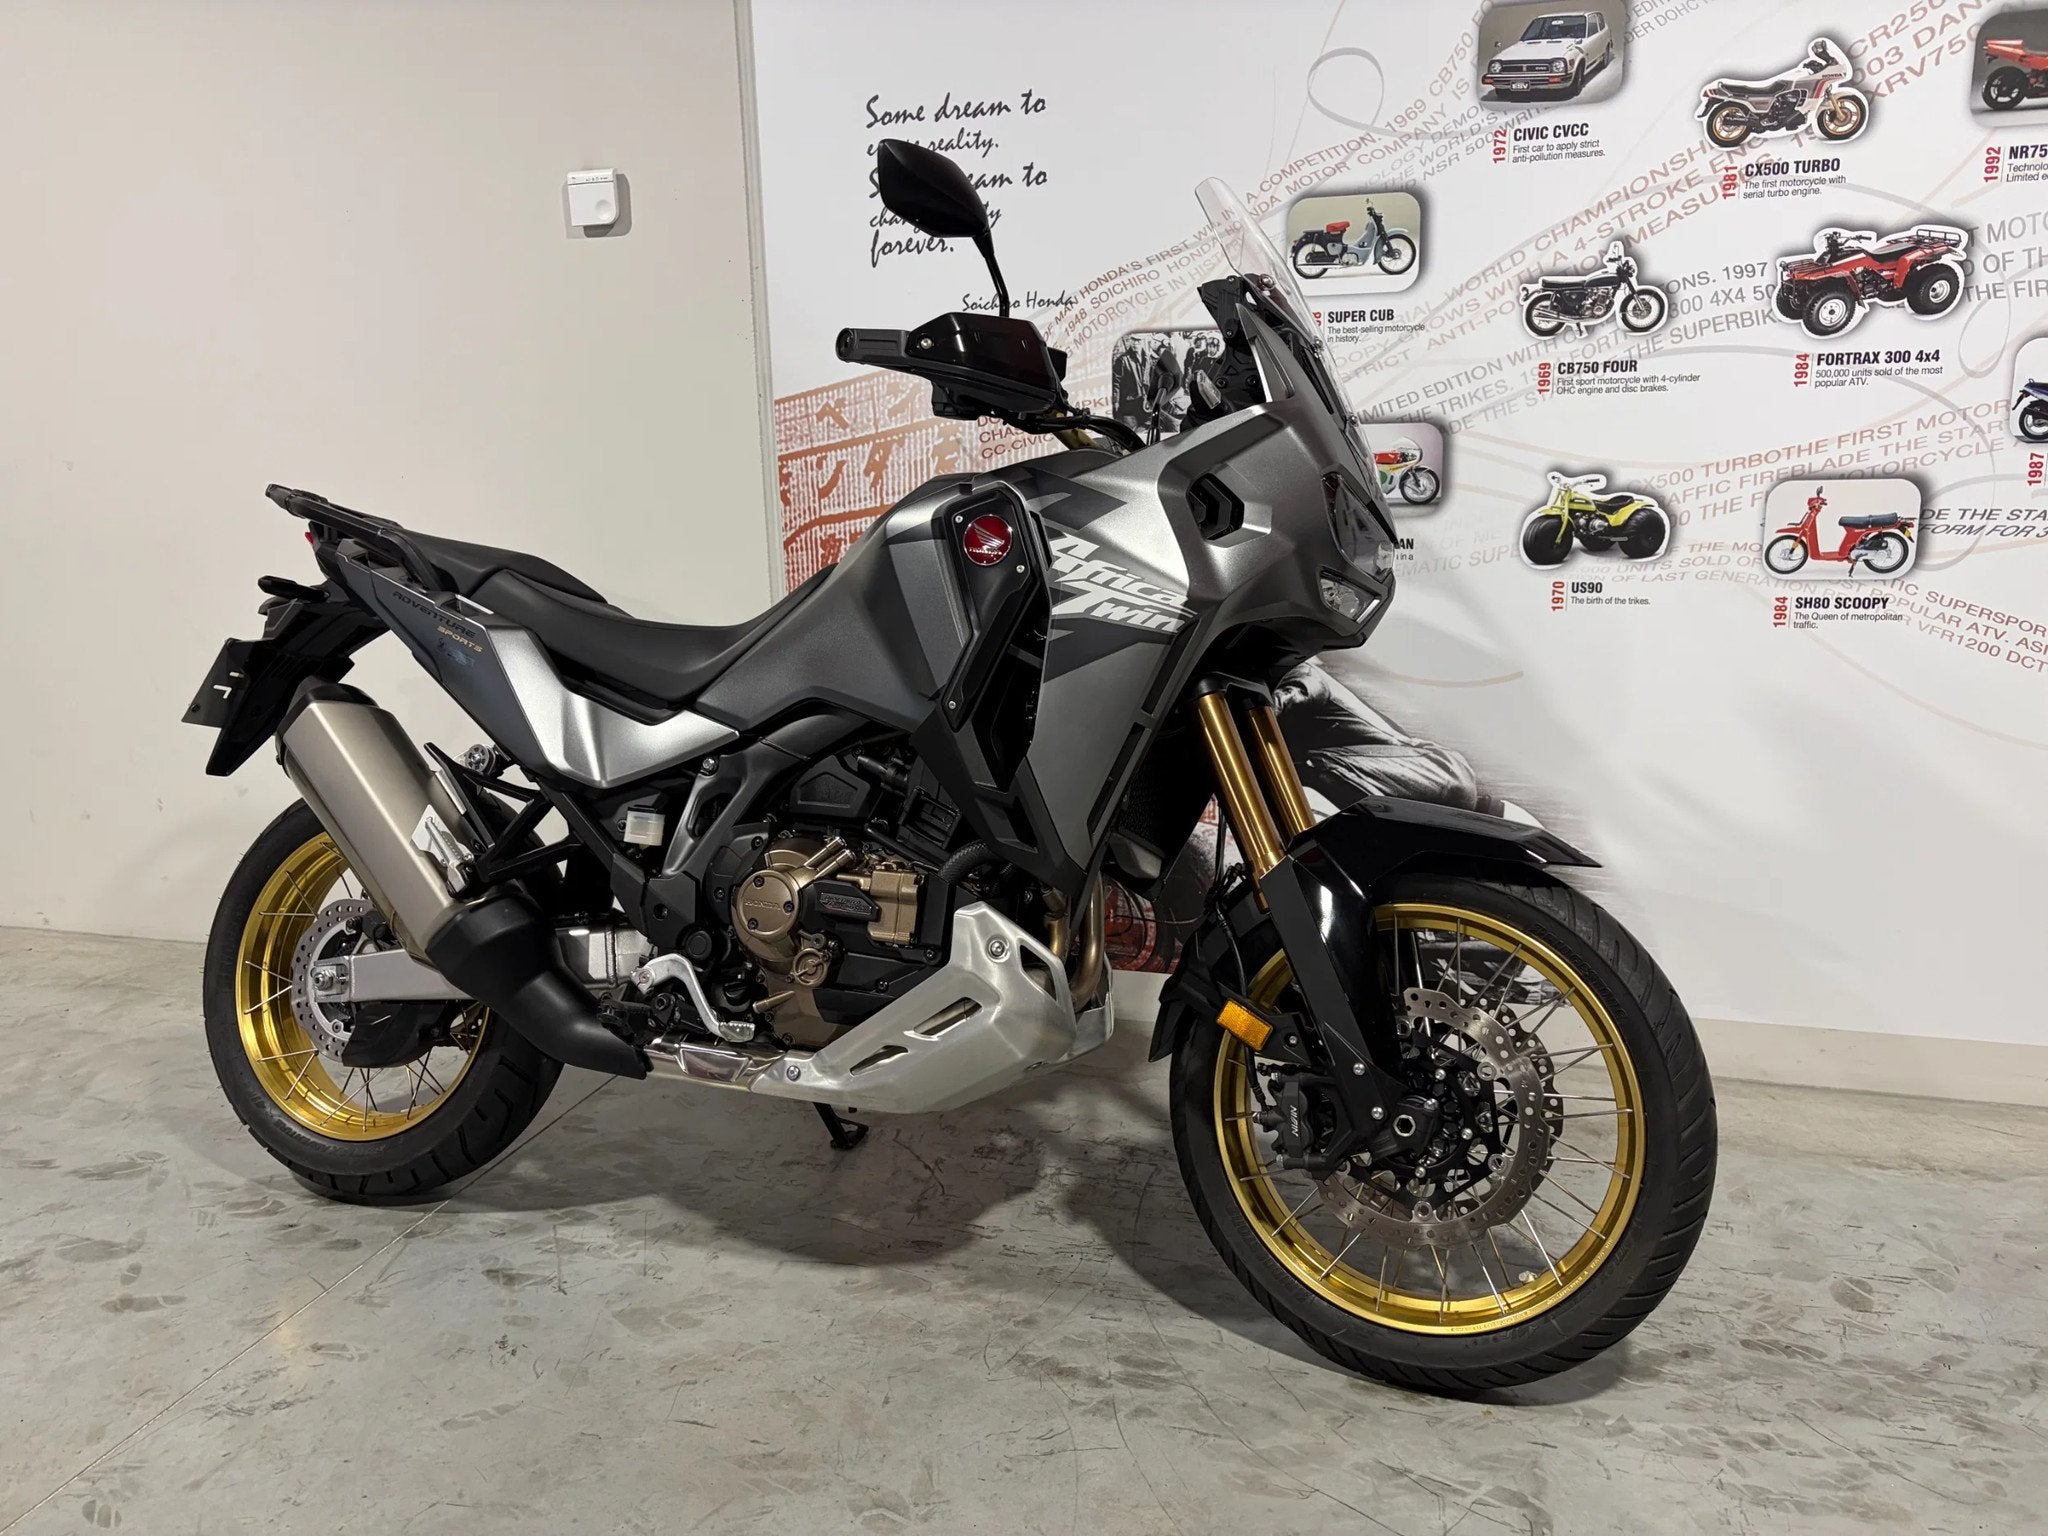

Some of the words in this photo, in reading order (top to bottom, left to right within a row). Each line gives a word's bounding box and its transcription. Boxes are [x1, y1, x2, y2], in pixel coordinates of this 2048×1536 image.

[866, 94, 925, 129] Some
[934, 92, 1011, 122] dream
[1021, 89, 1047, 114] to
[1513, 125, 1549, 142] CIVIC
[1553, 122, 1589, 138] CVCC
[1493, 129, 1508, 164] 1972
[1512, 144, 1529, 155] First
[1531, 145, 1544, 153] car
[1545, 143, 1555, 152] to
[1556, 141, 1581, 155] apply
[1583, 139, 1600, 150] strict
[1512, 151, 1563, 164] anti-pollution
[1565, 149, 1606, 160] measures.
[2009, 144, 2048, 160] NR75
[1022, 162, 1048, 187] to
[1082, 261, 1142, 299] HONDA'S
[1146, 240, 1188, 266] FIRST
[1259, 132, 1382, 193] COMPETITION.
[1385, 98, 1427, 133] 1969
[1428, 31, 1474, 97] CB750
[1423, 152, 1460, 180] NSR
[1744, 161, 1789, 177] CX500
[1794, 158, 1841, 174] TURBO
[1983, 146, 2001, 183] 1992
[2007, 162, 2048, 173] Technolo
[1722, 165, 1738, 199] 1981
[1744, 180, 1759, 189] The
[1761, 178, 1777, 188] first
[1779, 176, 1827, 189] motorcycle
[1829, 175, 1847, 185] with
[2006, 172, 2040, 183] Limited
[1743, 189, 1765, 199] serial
[1767, 188, 1789, 197] turbo
[1791, 187, 1822, 198] engine.
[1064, 309, 1088, 337] 1948
[1090, 269, 1160, 310] SOICHIRO
[1167, 237, 1219, 274] HONDA
[1285, 160, 1350, 196] MOTOR
[1357, 103, 1447, 165] COMPANY
[1485, 264, 1544, 301] WITH
[1574, 169, 1704, 252] 4-STROKE
[871, 228, 954, 268] forever.
[1722, 262, 1768, 281] 1997
[1983, 250, 2014, 273] OF
[1073, 283, 1166, 348] MOTORCYCLE
[1170, 277, 1187, 292] IN
[1328, 310, 1366, 324] SUPER
[1370, 309, 1394, 321] CUB
[1670, 308, 1779, 345] SUPERBIK
[1964, 282, 2006, 302] THE
[1328, 326, 1341, 335] The
[1342, 325, 1383, 336] best-selling
[1385, 323, 1425, 333] motorcycle
[1335, 335, 1362, 344] history.
[1436, 379, 1514, 415] TRIKES.
[1709, 284, 1747, 307] 4X4
[1816, 352, 1880, 366] FORTRAX
[1884, 351, 1911, 364] 300
[1915, 350, 1941, 363] 4x4
[1537, 362, 1551, 394] 1969
[1558, 361, 1599, 375] CB750
[1603, 360, 1638, 373] FOUR
[1793, 353, 1810, 387] 1984
[1815, 369, 1850, 380] 500,000
[1852, 368, 1872, 378] units
[1874, 367, 1895, 377] sold
[1896, 367, 1904, 376] of
[1905, 366, 1919, 376] the
[1920, 366, 1943, 375] most
[1357, 391, 1420, 423] IMITED
[1423, 358, 1503, 398] EDITION
[1507, 338, 1558, 367] WITH
[1557, 377, 1574, 385] First
[1575, 377, 1595, 387] sport
[1597, 375, 1641, 386] motorcycle
[1642, 375, 1659, 383] with
[1660, 373, 1701, 385] 4-cylinder
[1557, 386, 1576, 394] OHC
[1577, 386, 1604, 395] engine
[1605, 385, 1620, 393] and
[1621, 384, 1639, 393] disc
[1640, 383, 1669, 392] brakes.
[1814, 378, 1847, 389] popular
[1849, 377, 1869, 387] ATV.
[1837, 421, 1907, 449] FIRST
[1739, 449, 1871, 489] FIREBLADE
[1879, 436, 1928, 456] THE
[2027, 453, 2044, 486] 1987
[1699, 496, 1743, 520] THE
[1958, 508, 2002, 521] THE
[1986, 525, 2033, 538] FOR
[1551, 581, 1565, 612] 1970
[1571, 582, 1603, 593] US90
[1571, 596, 1585, 604] The
[1586, 596, 1603, 604] birth
[1604, 596, 1613, 605] of
[1614, 596, 1626, 605] the
[1627, 597, 1651, 605] trikes.
[1678, 555, 1731, 568] SOLD
[1869, 587, 1962, 628] POPULAR
[1966, 622, 2010, 643] ATV.
[1795, 597, 1830, 609] SH80
[1834, 597, 1890, 609] SCOOPY
[392, 591, 476, 638] ADVENTURE
[1773, 596, 1788, 628] 1984
[1794, 612, 1809, 620] The
[1811, 612, 1839, 621] Queen
[1840, 612, 1849, 620] of
[1850, 613, 1903, 622] metropolitan
[1793, 621, 1818, 629] traffic.
[436, 625, 484, 652] SPORTS
